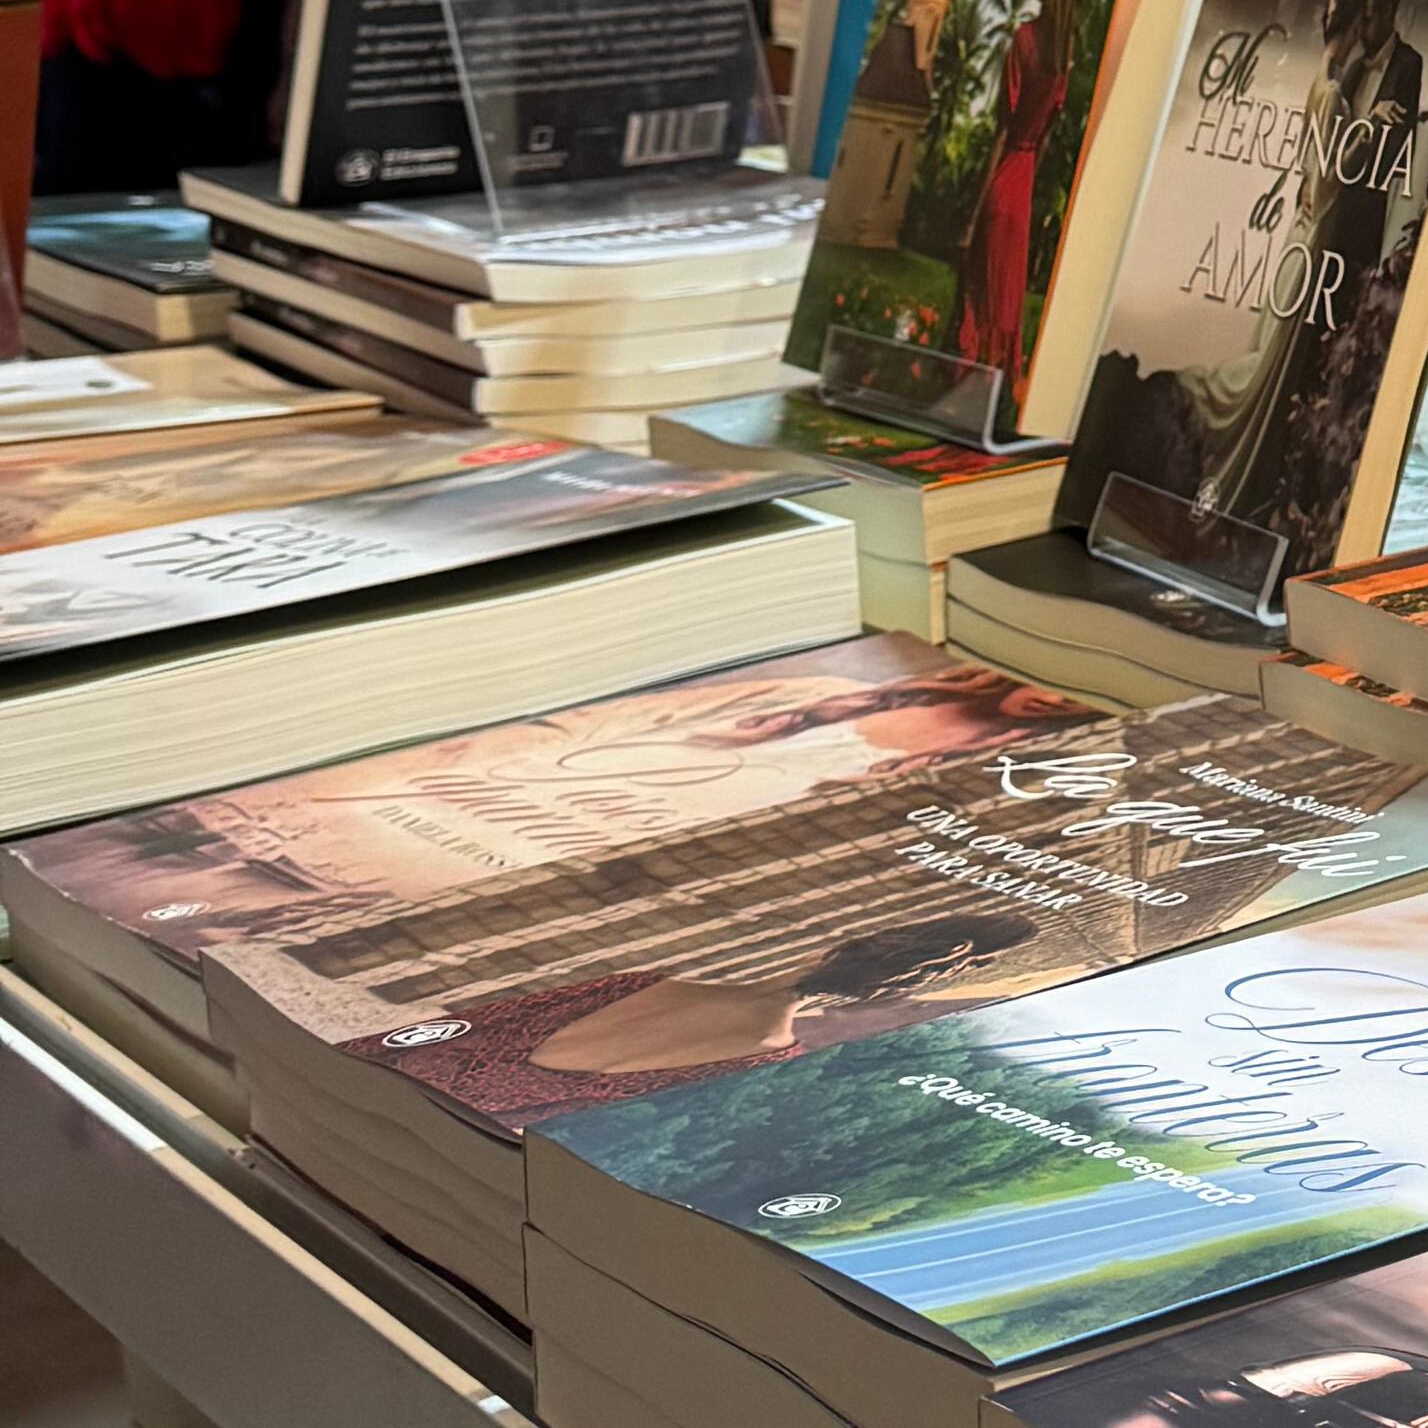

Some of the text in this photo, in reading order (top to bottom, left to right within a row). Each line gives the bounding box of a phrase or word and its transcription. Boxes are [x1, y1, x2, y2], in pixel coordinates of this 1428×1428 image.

[1184, 95, 1415, 198] HERENCIA
[1248, 171, 1287, 234] de
[1180, 221, 1346, 332] AMOR
[983, 752, 1138, 800] La
[1180, 760, 1385, 828] Mariana Santini
[906, 804, 1190, 909] UNA OPORTUNIDAD
[1061, 800, 1266, 846] que
[1179, 830, 1408, 877] fui
[896, 840, 1084, 913] PARA SANAR
[1208, 1047, 1341, 1088] sin
[898, 1072, 1257, 1208] ¿Qué camino te espera?
[963, 1028, 1427, 1193] fronteras
